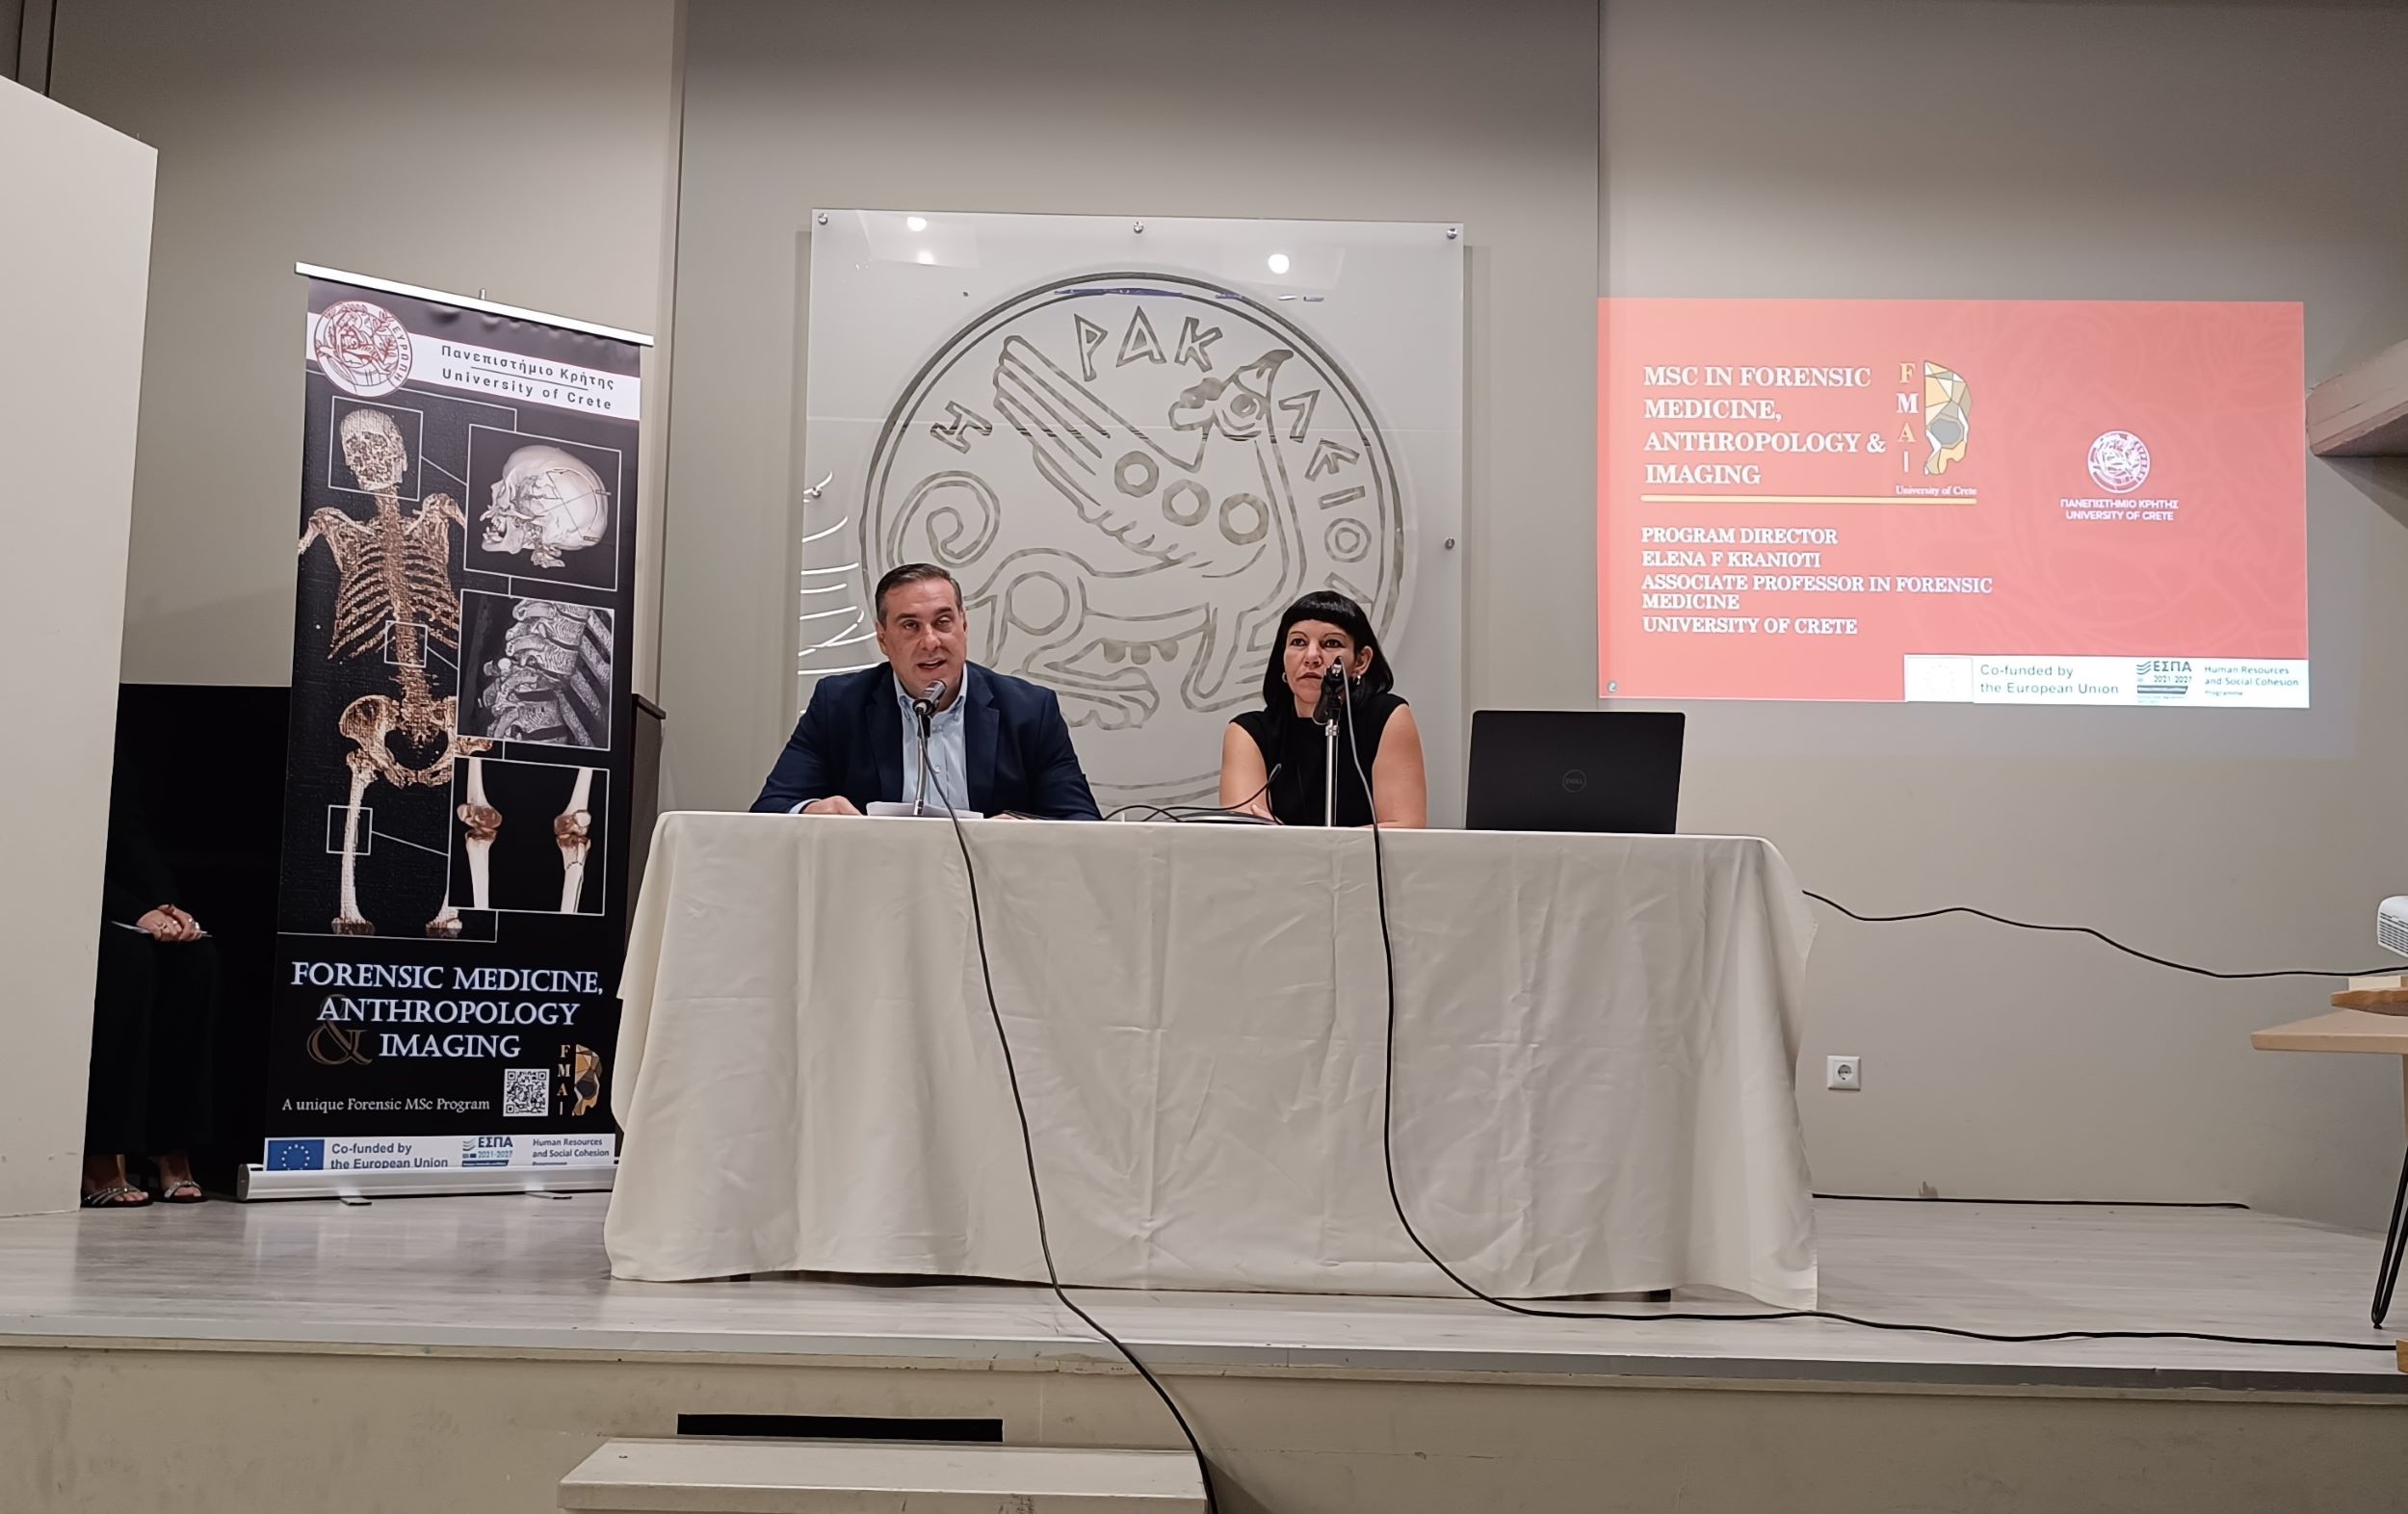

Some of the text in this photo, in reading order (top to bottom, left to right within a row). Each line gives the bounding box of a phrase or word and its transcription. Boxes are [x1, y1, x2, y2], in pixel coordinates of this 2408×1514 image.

[441, 345, 615, 390] Πανεπιστήμιο Κρήτης
[1643, 366, 1871, 387] MSC IN FORENSIC
[442, 368, 612, 410] University of Crete
[1643, 399, 1782, 422] MEDICINE,
[1643, 431, 1886, 453] ANTHROPOLOGY &
[1645, 464, 1762, 483] IMAGING
[1896, 485, 1977, 497] University of Crete
[2060, 499, 2179, 509] ΠΑΝΕΠΙΣΤΗΜΙΟ ΚΡΗΤΗΣ
[2066, 510, 2174, 520] UNIVERSITY OF CRETE
[1641, 527, 1838, 545] PROGRAM DIRECTOR
[1641, 551, 1821, 568] ELENA F KRANIOTI
[1641, 574, 1993, 593] ASSOCIATE PROFESSOR IN FORENSIC
[1641, 593, 1741, 609] MEDICINE
[1641, 616, 1858, 635] UNIVERSITY OF CRETE
[1980, 664, 2074, 678] Co-funded by
[2153, 661, 2192, 672] ΕΣΠΑ
[2205, 666, 2290, 675] Human Resources
[1980, 682, 2119, 695] the European Union
[2205, 677, 2299, 687] and Social Cohesion
[291, 961, 603, 995] FORENSIC MEDICINE,
[317, 998, 580, 1026] ANTHROPOLOGY
[306, 993, 522, 1065] & IMAGING
[282, 1098, 490, 1114] A unique Forensic MSc Program
[331, 1142, 412, 1156] Co-funded by
[478, 1136, 513, 1148] ΕΣΠΑ
[563, 1137, 602, 1146] Resources
[549, 1149, 573, 1158] Social
[574, 1148, 610, 1157] Cohesion
[330, 1159, 350, 1169] the
[353, 1159, 411, 1169] European
[414, 1157, 449, 1168] Union
